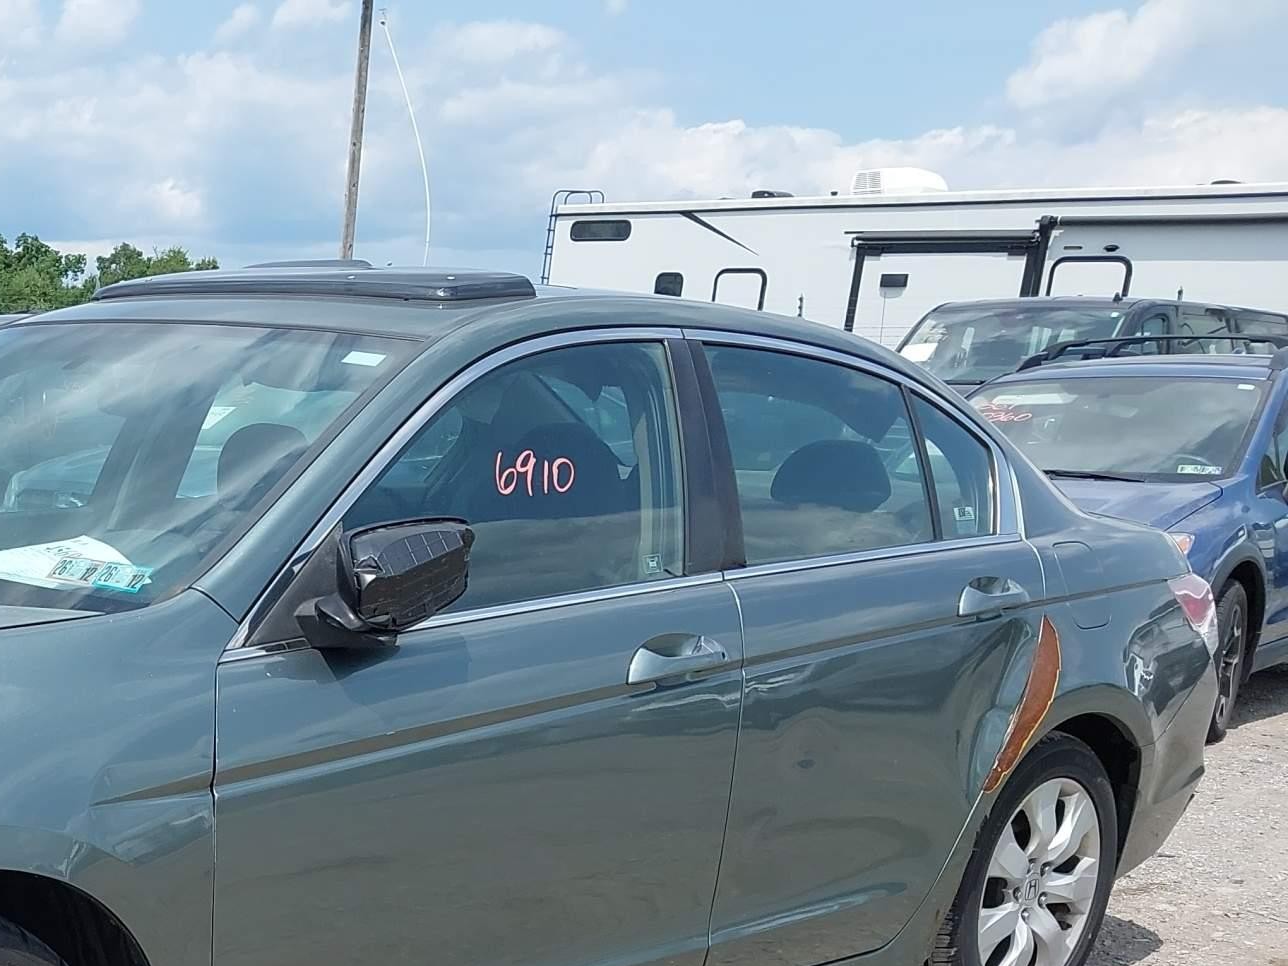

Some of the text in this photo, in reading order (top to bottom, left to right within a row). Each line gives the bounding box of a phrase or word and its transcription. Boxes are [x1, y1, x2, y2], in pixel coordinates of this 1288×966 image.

[495, 449, 575, 496] 6910
[52, 558, 73, 577] 26
[79, 566, 99, 582] 12
[98, 565, 118, 583] 26
[126, 573, 146, 588] 12
